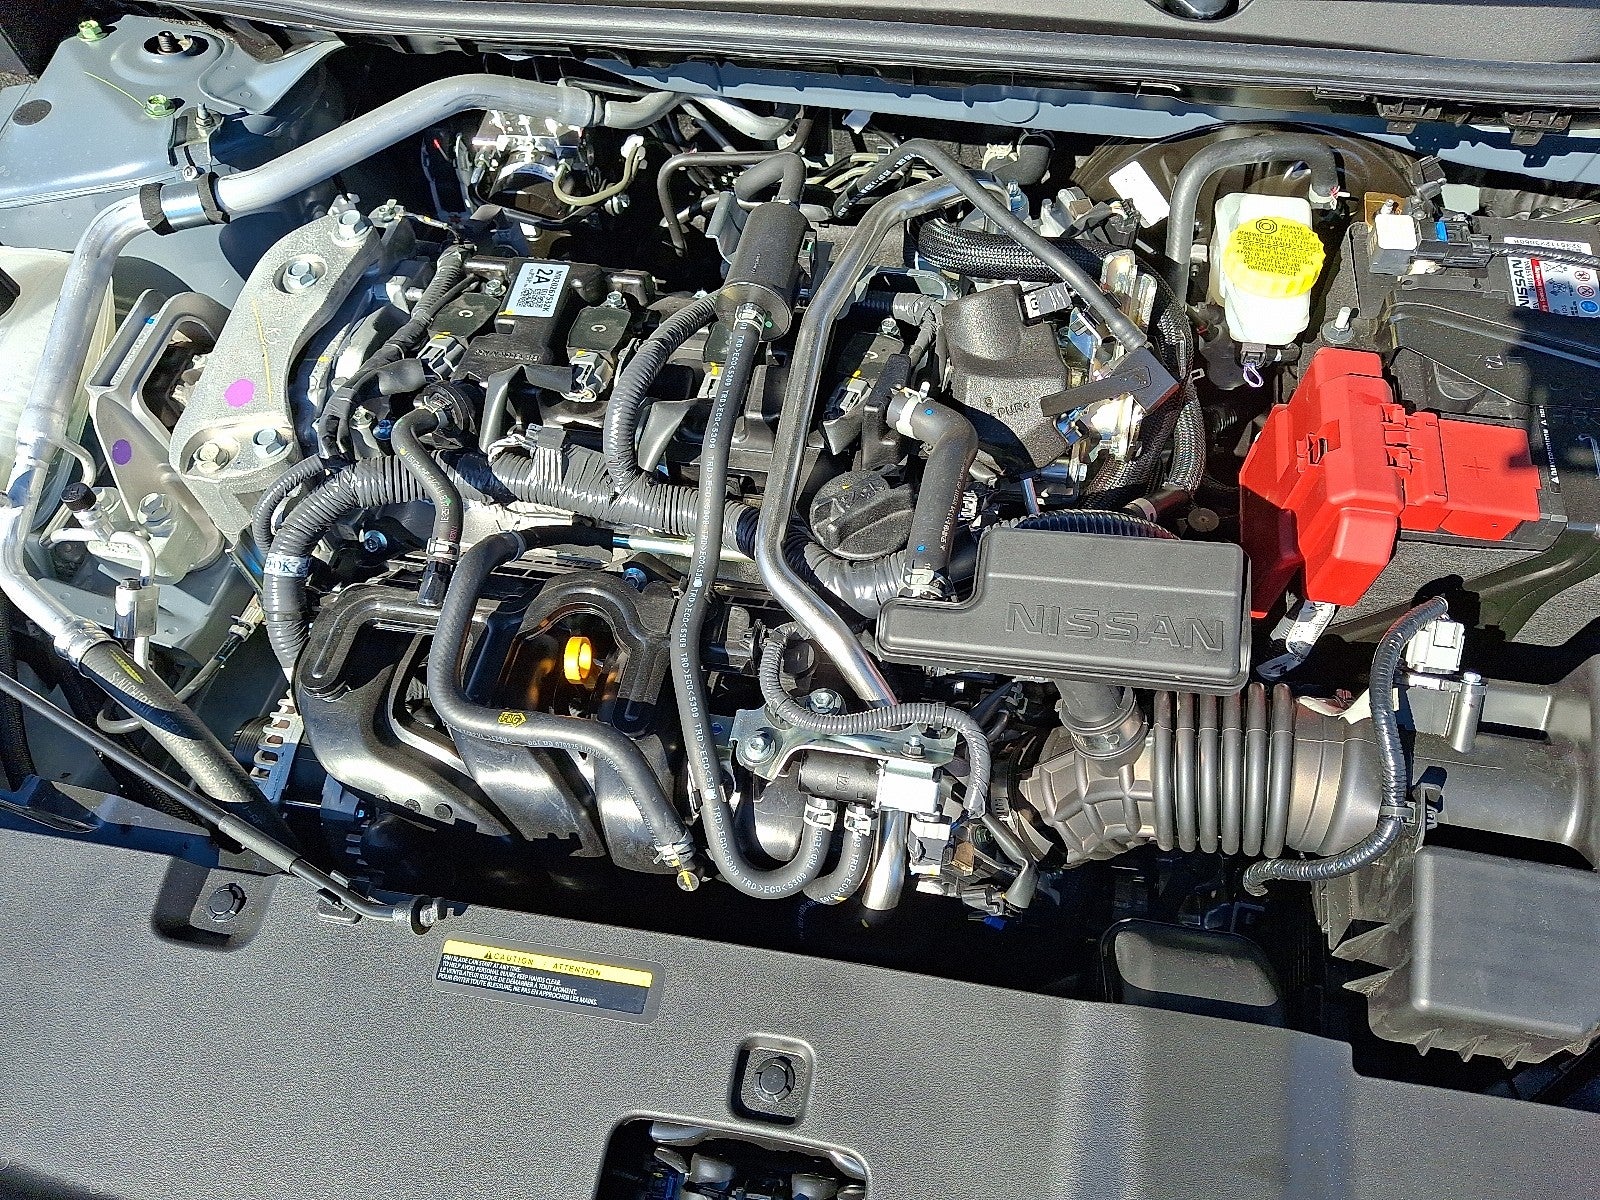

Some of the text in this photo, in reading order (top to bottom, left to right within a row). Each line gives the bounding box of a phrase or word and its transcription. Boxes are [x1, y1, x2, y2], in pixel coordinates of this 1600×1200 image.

[533, 268, 554, 285] 2A
[1512, 259, 1530, 307] NISSAN
[1005, 601, 1224, 651] NISSAN
[492, 951, 601, 977] CAUTION ATTENTION
